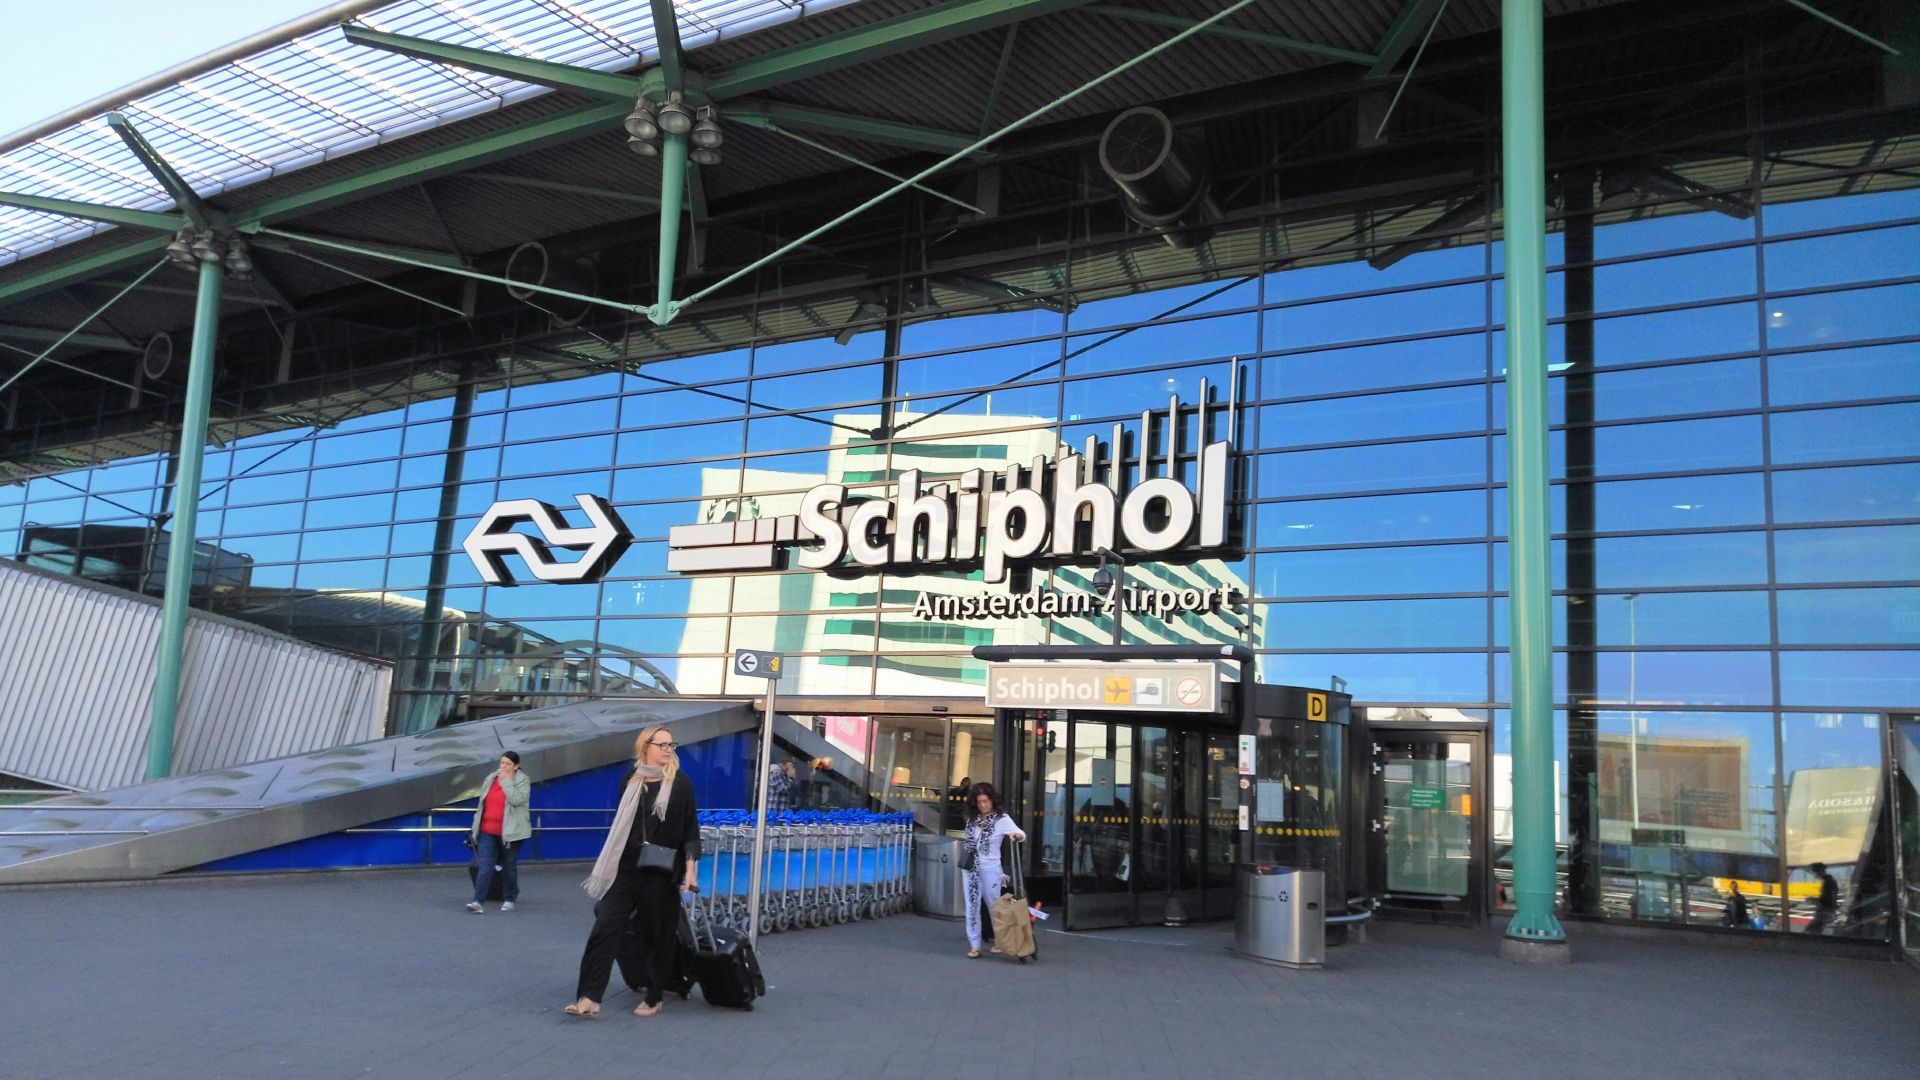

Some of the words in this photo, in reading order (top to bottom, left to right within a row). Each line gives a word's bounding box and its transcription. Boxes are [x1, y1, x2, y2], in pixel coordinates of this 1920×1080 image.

[798, 440, 1230, 583] Schiphol
[912, 585, 1091, 617] Amsterdam
[1103, 579, 1234, 619] Airport
[996, 676, 1099, 703] Schiphol
[1311, 696, 1323, 717] D
